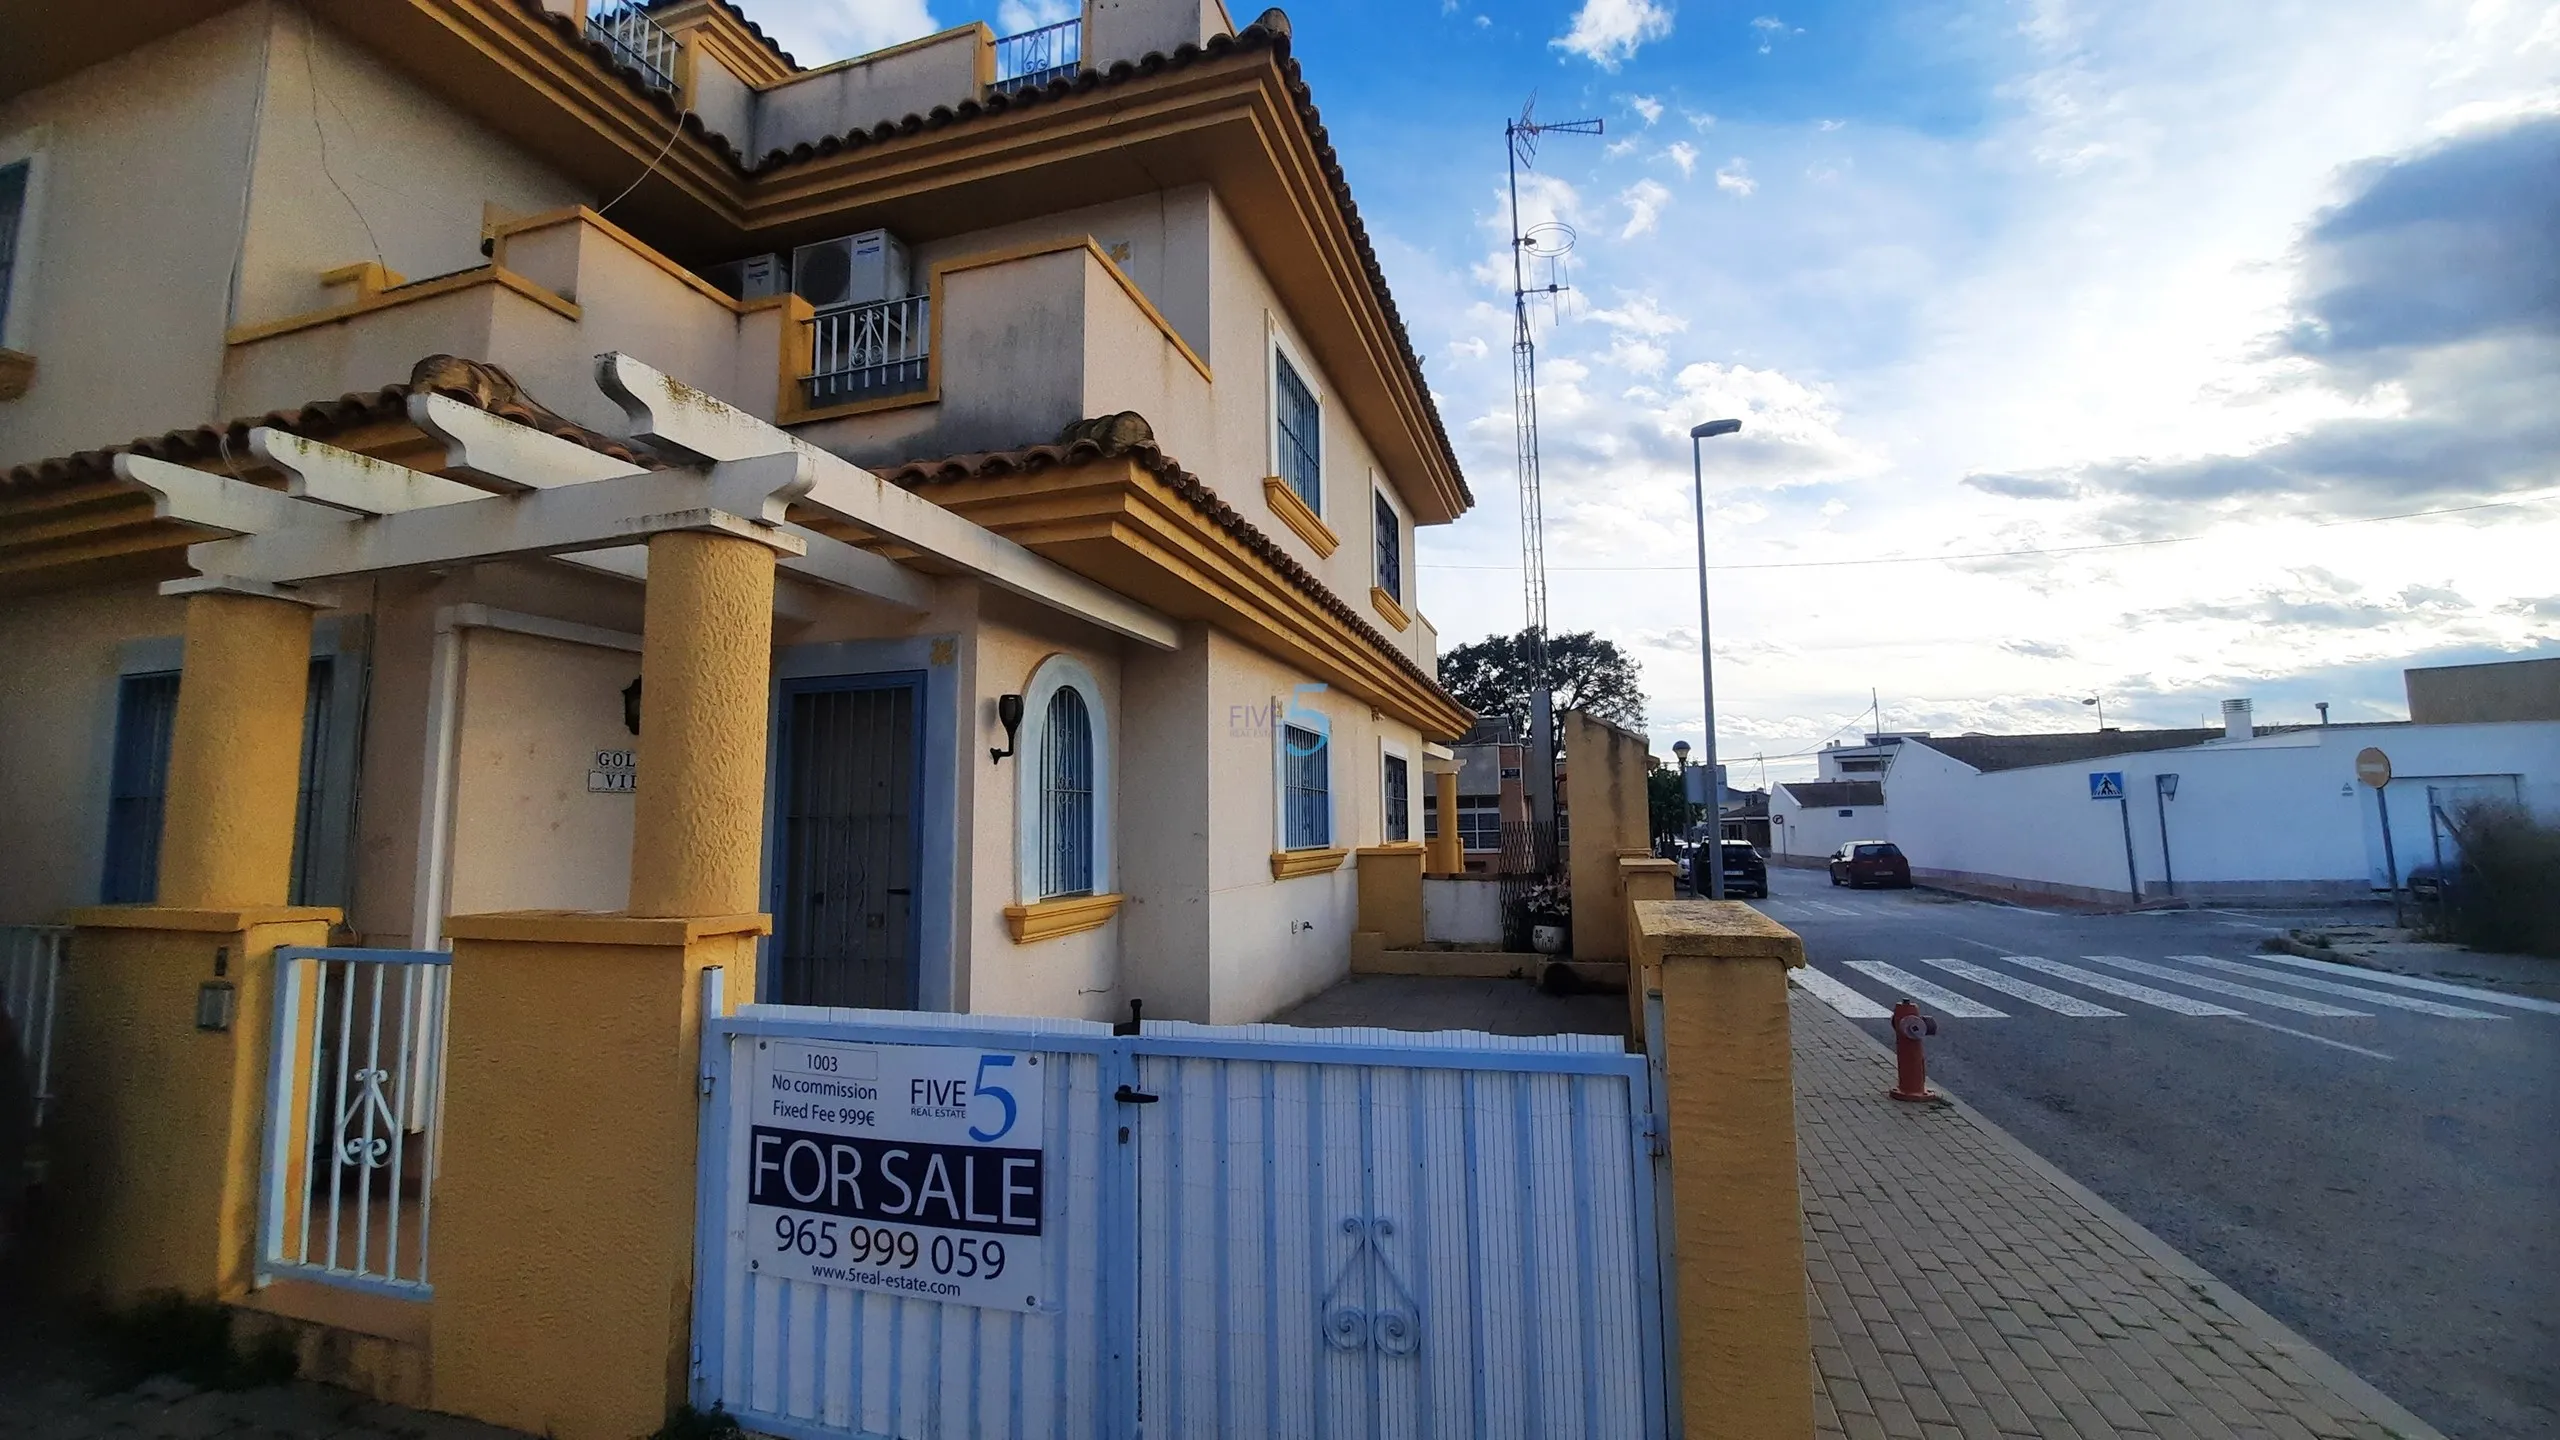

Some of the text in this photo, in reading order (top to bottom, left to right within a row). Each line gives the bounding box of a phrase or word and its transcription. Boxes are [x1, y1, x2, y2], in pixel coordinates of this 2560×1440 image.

[807, 1053, 838, 1072] 1003
[772, 1074, 877, 1100] No commission
[910, 1054, 1017, 1143] FIVE 5
[773, 1100, 875, 1126] Fixed Fee 999€
[910, 1107, 966, 1119] REAL ESTATE
[754, 1134, 1037, 1227] FOR SALE
[775, 1214, 1006, 1280] 965 999 059
[811, 1264, 961, 1297] www.5real-estate.com
